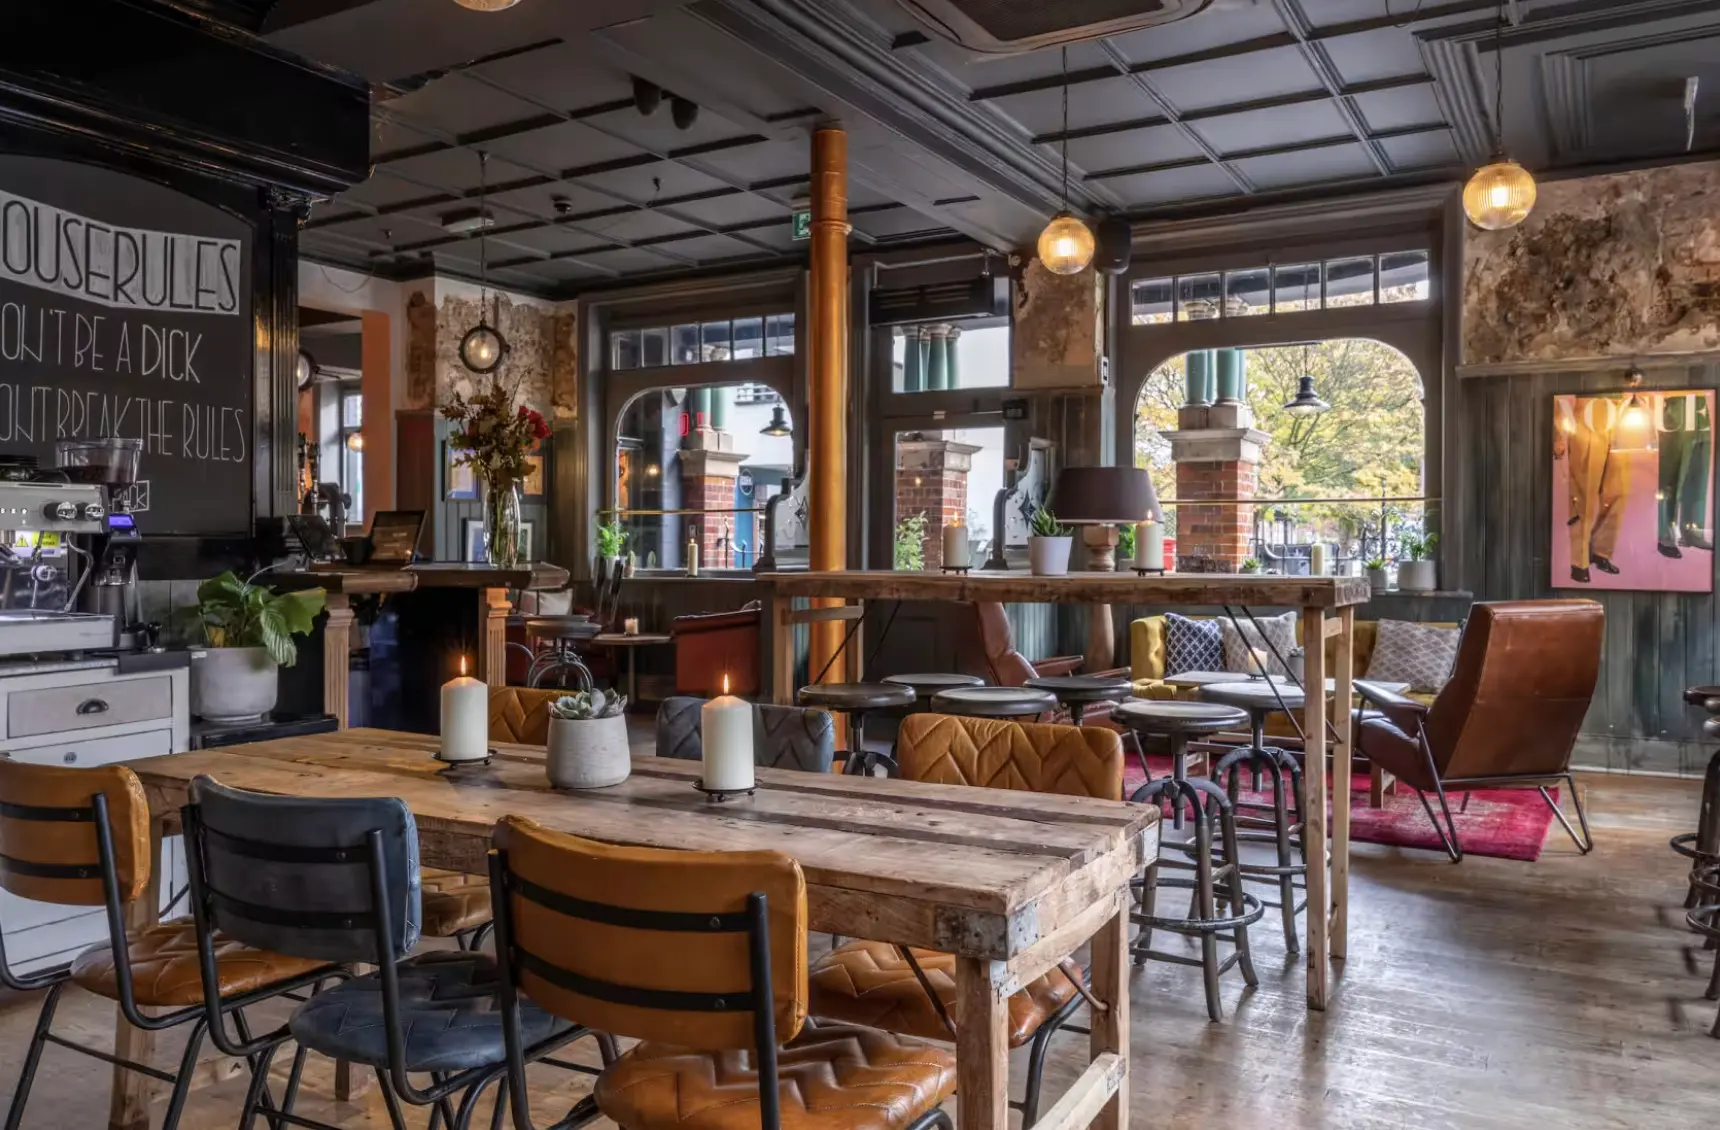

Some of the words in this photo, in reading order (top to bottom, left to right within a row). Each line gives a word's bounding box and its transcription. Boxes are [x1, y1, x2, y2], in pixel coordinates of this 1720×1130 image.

[75, 313, 106, 371] BE
[116, 321, 132, 374] A
[142, 324, 202, 384] DICK
[136, 397, 173, 455] THE
[183, 403, 245, 463] RULES
